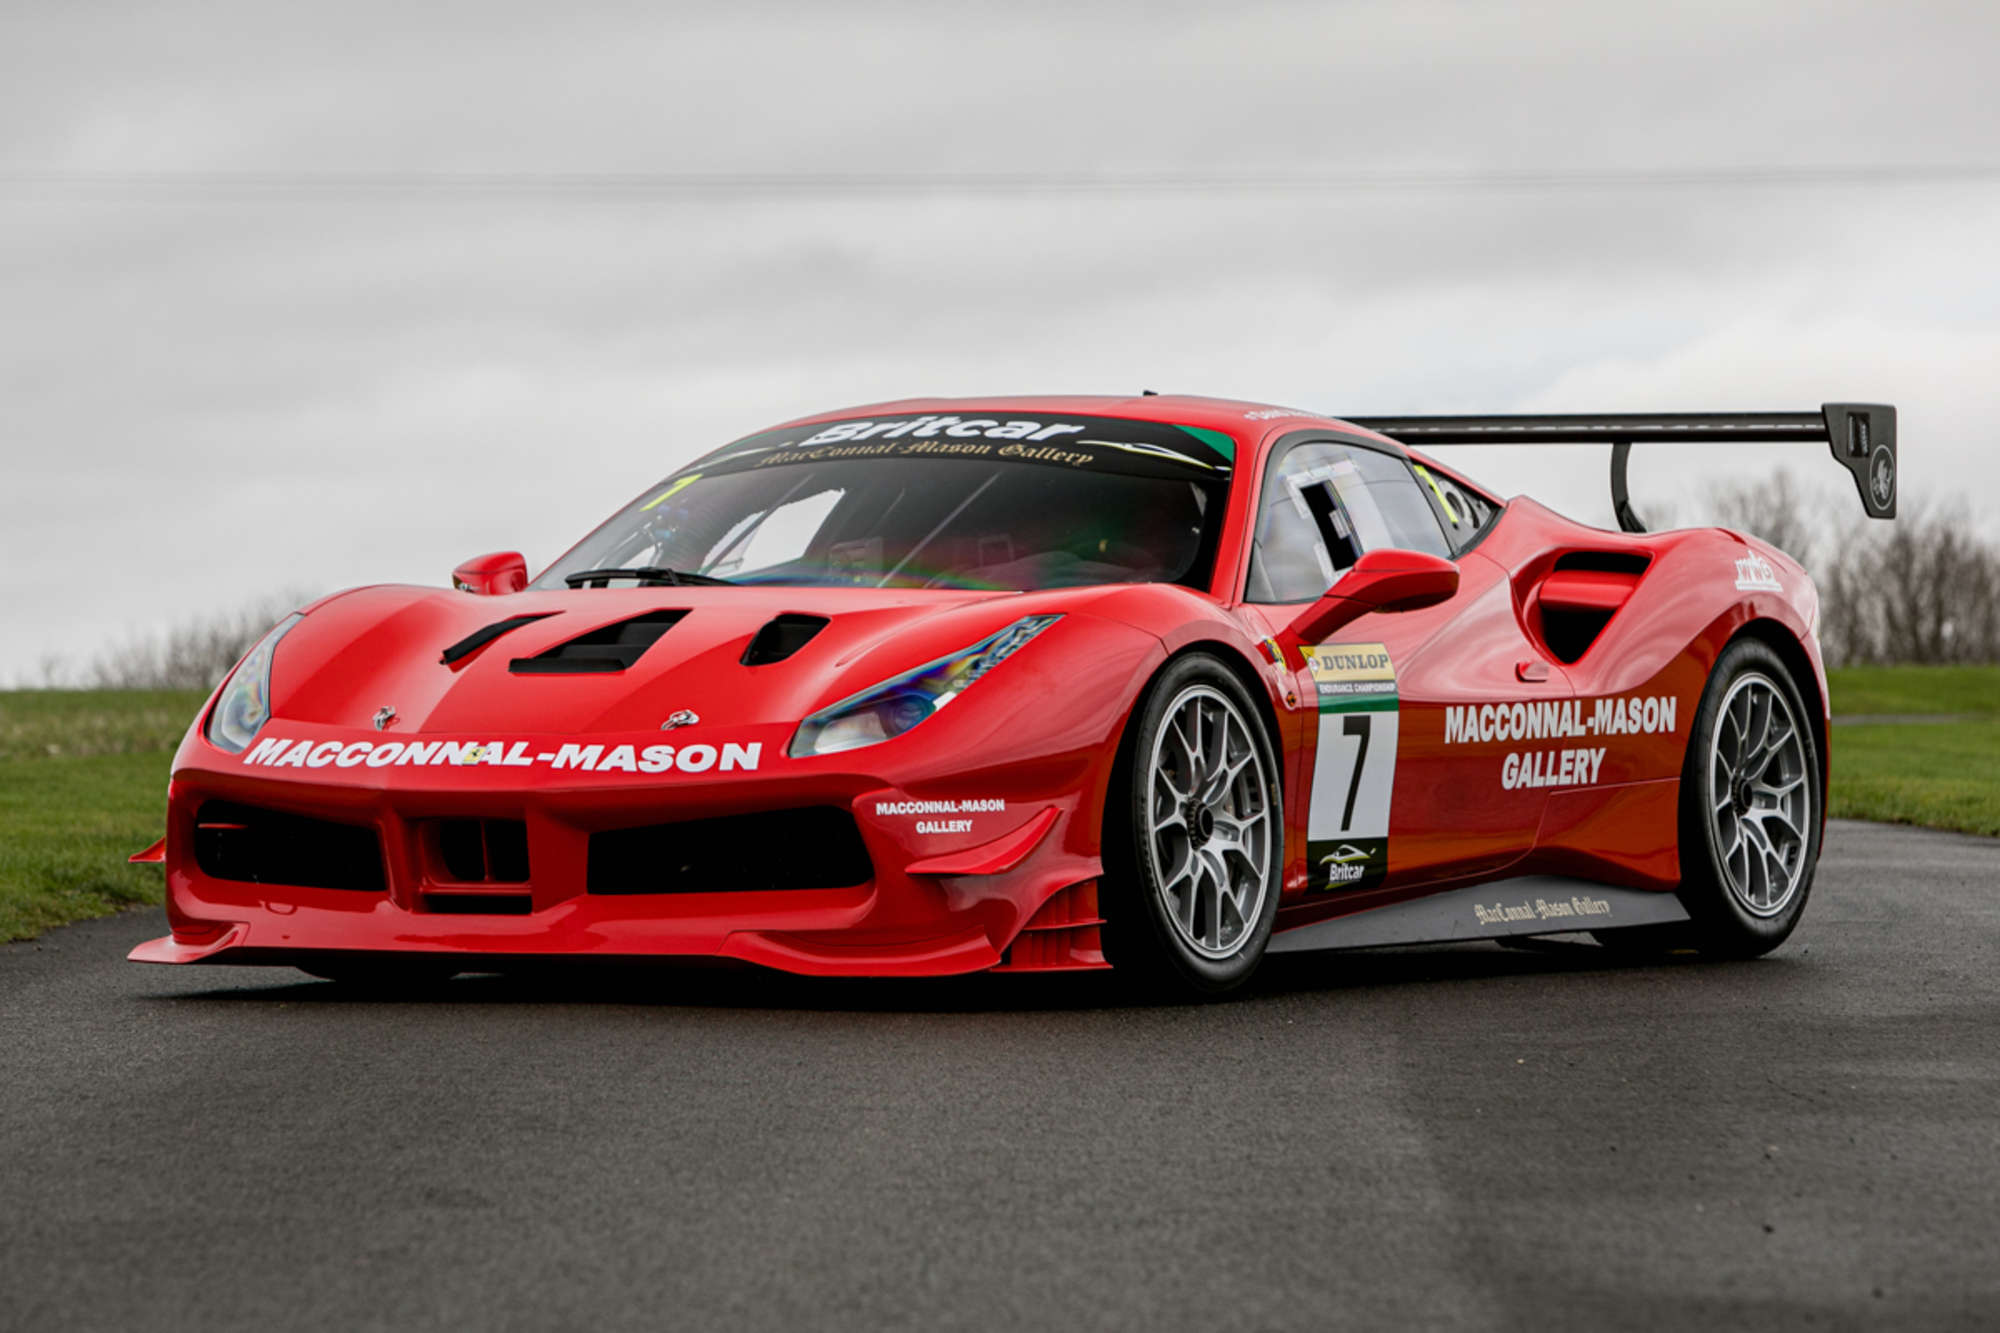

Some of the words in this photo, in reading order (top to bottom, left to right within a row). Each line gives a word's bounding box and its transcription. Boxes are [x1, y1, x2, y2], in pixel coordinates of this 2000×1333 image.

[798, 416, 1085, 447] Britcar
[998, 443, 1094, 468] Gallery
[1321, 654, 1389, 671] DUNLOP
[1444, 696, 1677, 744] MACCONNAL-MASON
[1342, 715, 1371, 832] 7
[1501, 747, 1607, 790] GALLERY
[875, 799, 1006, 815] MACCONNAL-MASON
[915, 819, 973, 834] GALLERY
[1329, 862, 1365, 881] Britcar
